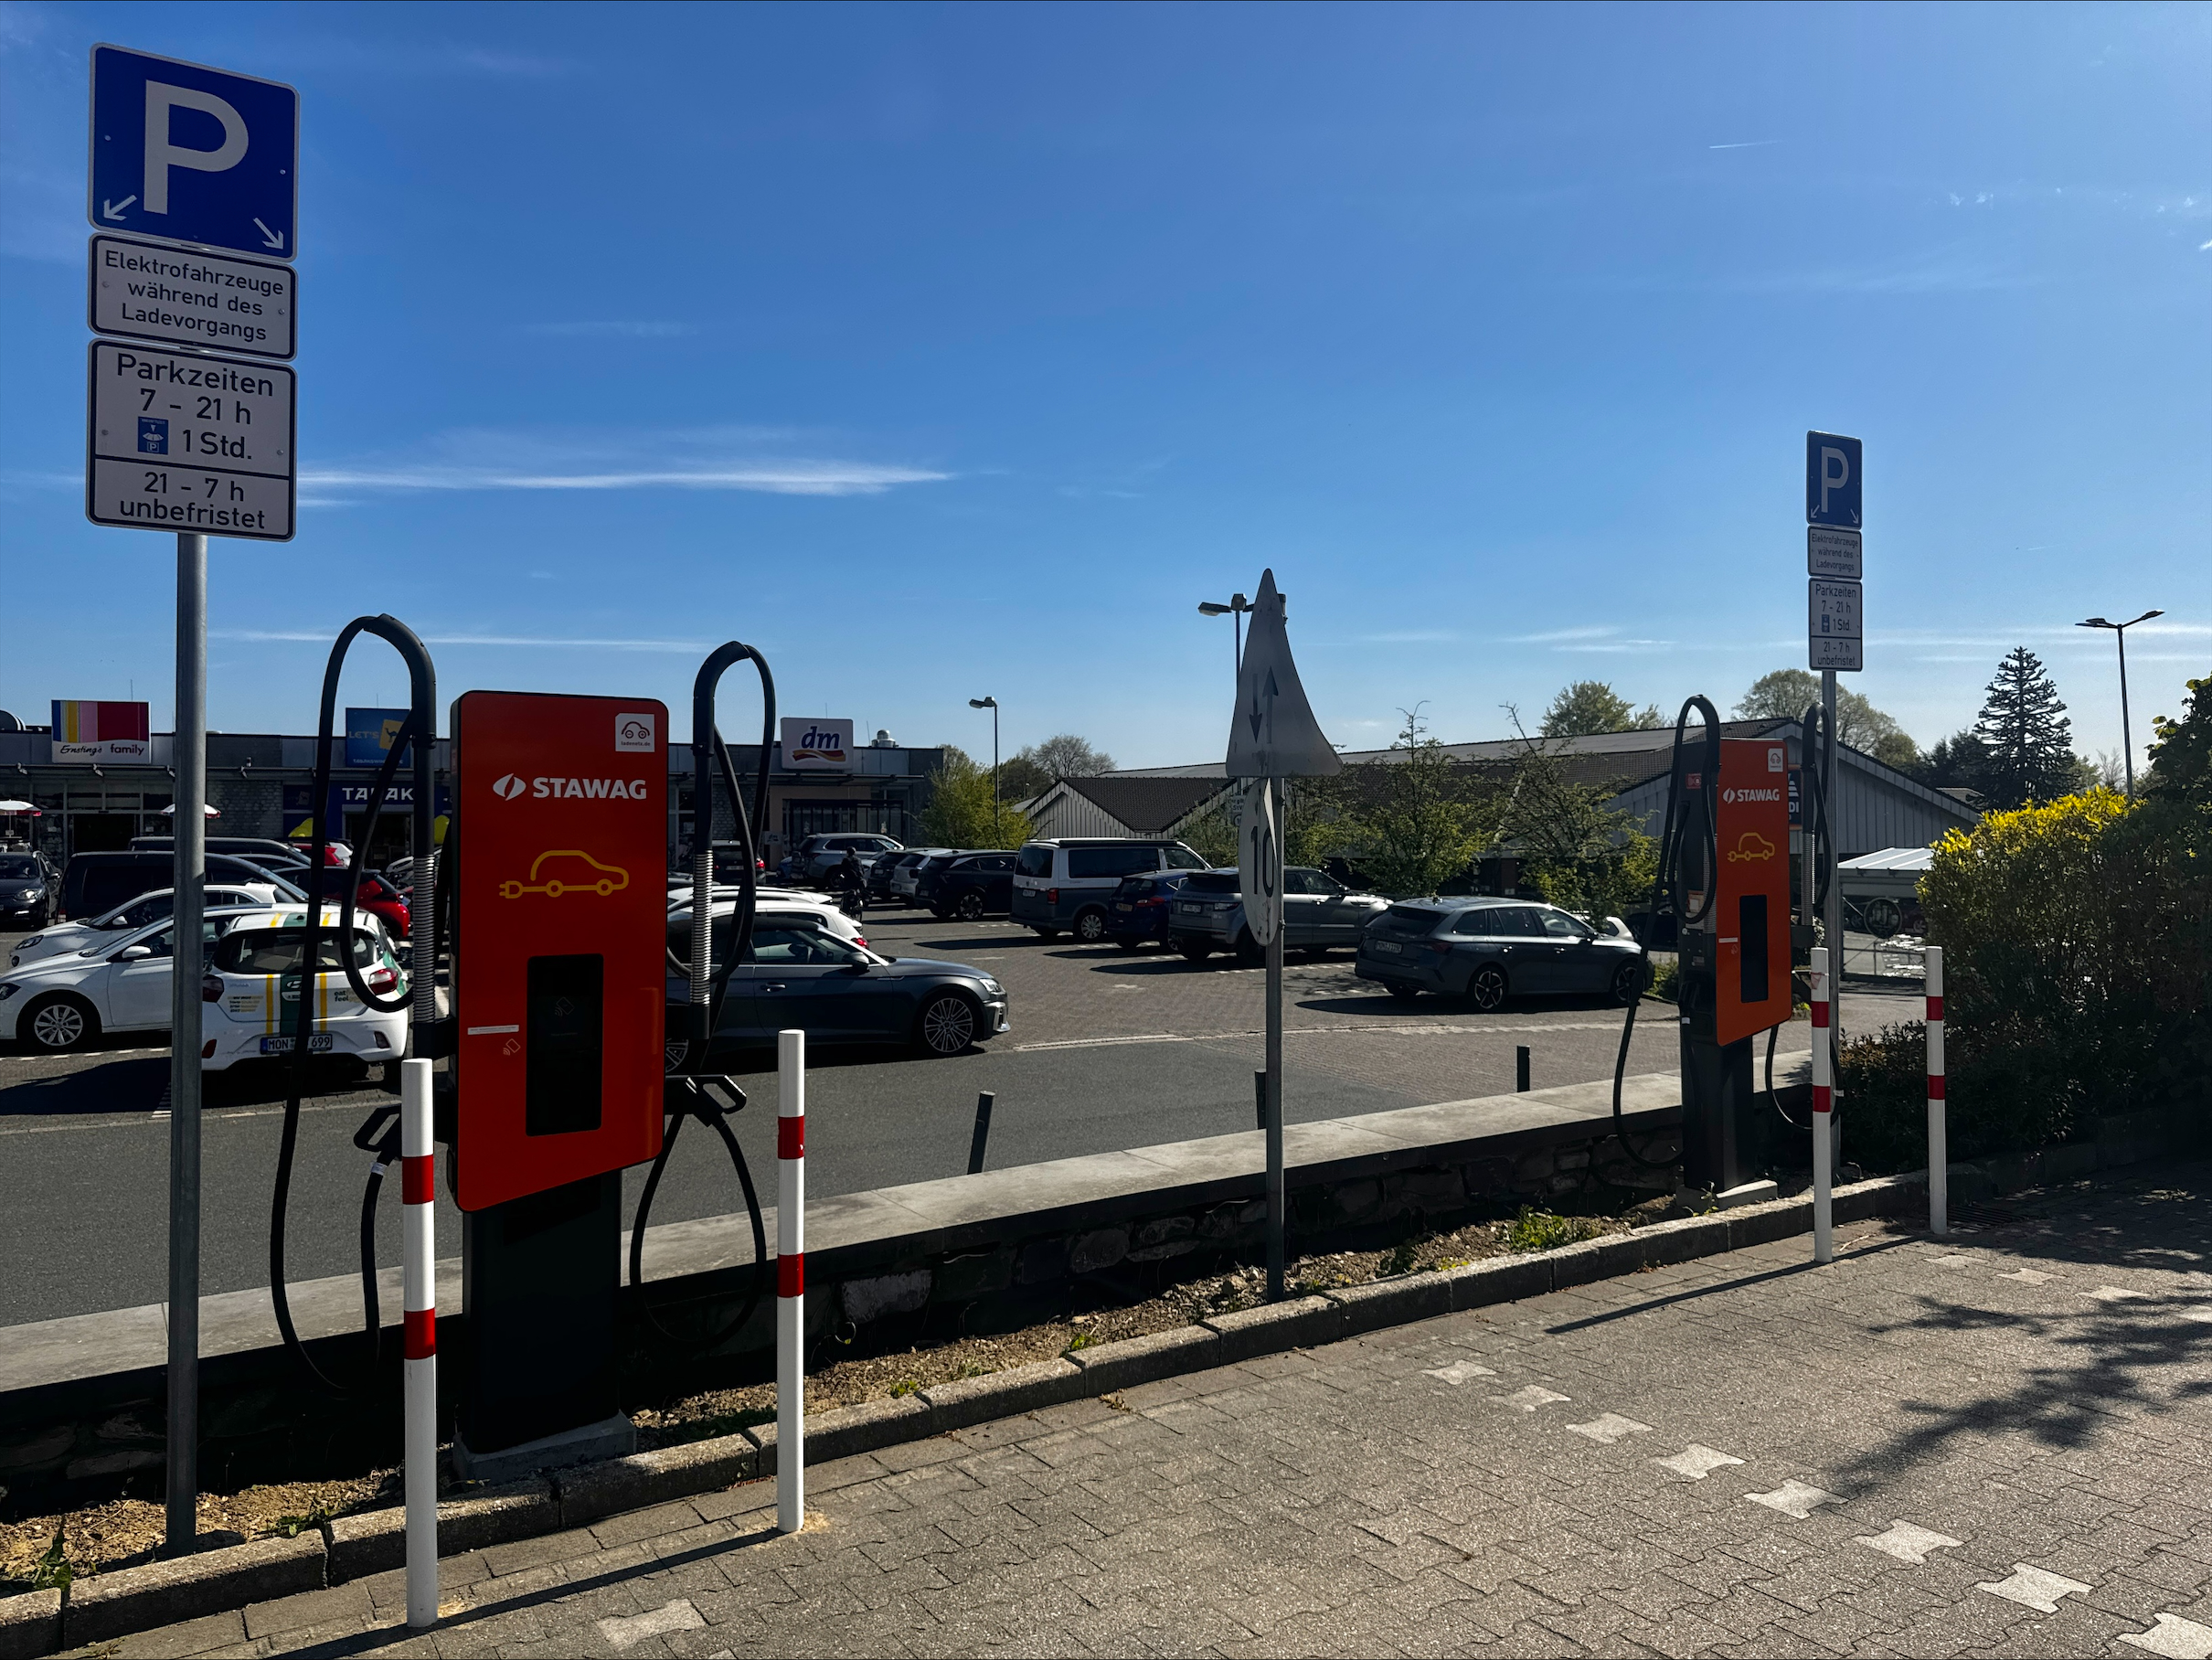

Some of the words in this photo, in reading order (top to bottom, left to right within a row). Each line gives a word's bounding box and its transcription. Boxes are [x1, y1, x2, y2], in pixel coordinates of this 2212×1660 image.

[144, 79, 250, 216] P
[105, 250, 283, 297] Elektrofahrzeuge
[127, 282, 218, 309] während
[228, 295, 263, 315] des
[122, 303, 267, 342] Ladevorgangs
[117, 352, 273, 397] Parkzeiten
[140, 388, 156, 411] 7
[196, 396, 221, 420] 21
[235, 400, 251, 425] h
[183, 429, 191, 452] 1
[200, 431, 252, 460] Std.
[144, 472, 167, 494] 21
[205, 477, 218, 498] 7
[230, 480, 244, 502] h
[1821, 445, 1849, 513] P
[120, 498, 265, 529] unbefristet
[1812, 533, 1858, 548] Elektrofahrzeuge
[1817, 547, 1842, 558] während
[1843, 550, 1854, 559] des
[1815, 559, 1855, 572] Ladevorgangs
[1815, 584, 1856, 598] Parkzeiten
[1822, 600, 1826, 612] 7
[1836, 601, 1844, 613] 21
[1846, 601, 1851, 613] h
[1833, 618, 1836, 630] 1
[1837, 619, 1852, 631] Std.
[1824, 641, 1830, 653] 21
[1839, 642, 1844, 653] 7
[1846, 642, 1850, 653] h
[1817, 655, 1856, 665] unbefristet
[348, 730, 380, 739] LET'S
[801, 726, 840, 749] dm
[60, 744, 102, 756] Ernsting's
[110, 743, 145, 756] family
[533, 777, 647, 800] STAWAG
[1737, 788, 1781, 803] STAWAG
[1788, 801, 1800, 813] DI
[1250, 825, 1275, 898] 10
[268, 1038, 289, 1050] MON
[312, 1037, 330, 1048] 699
